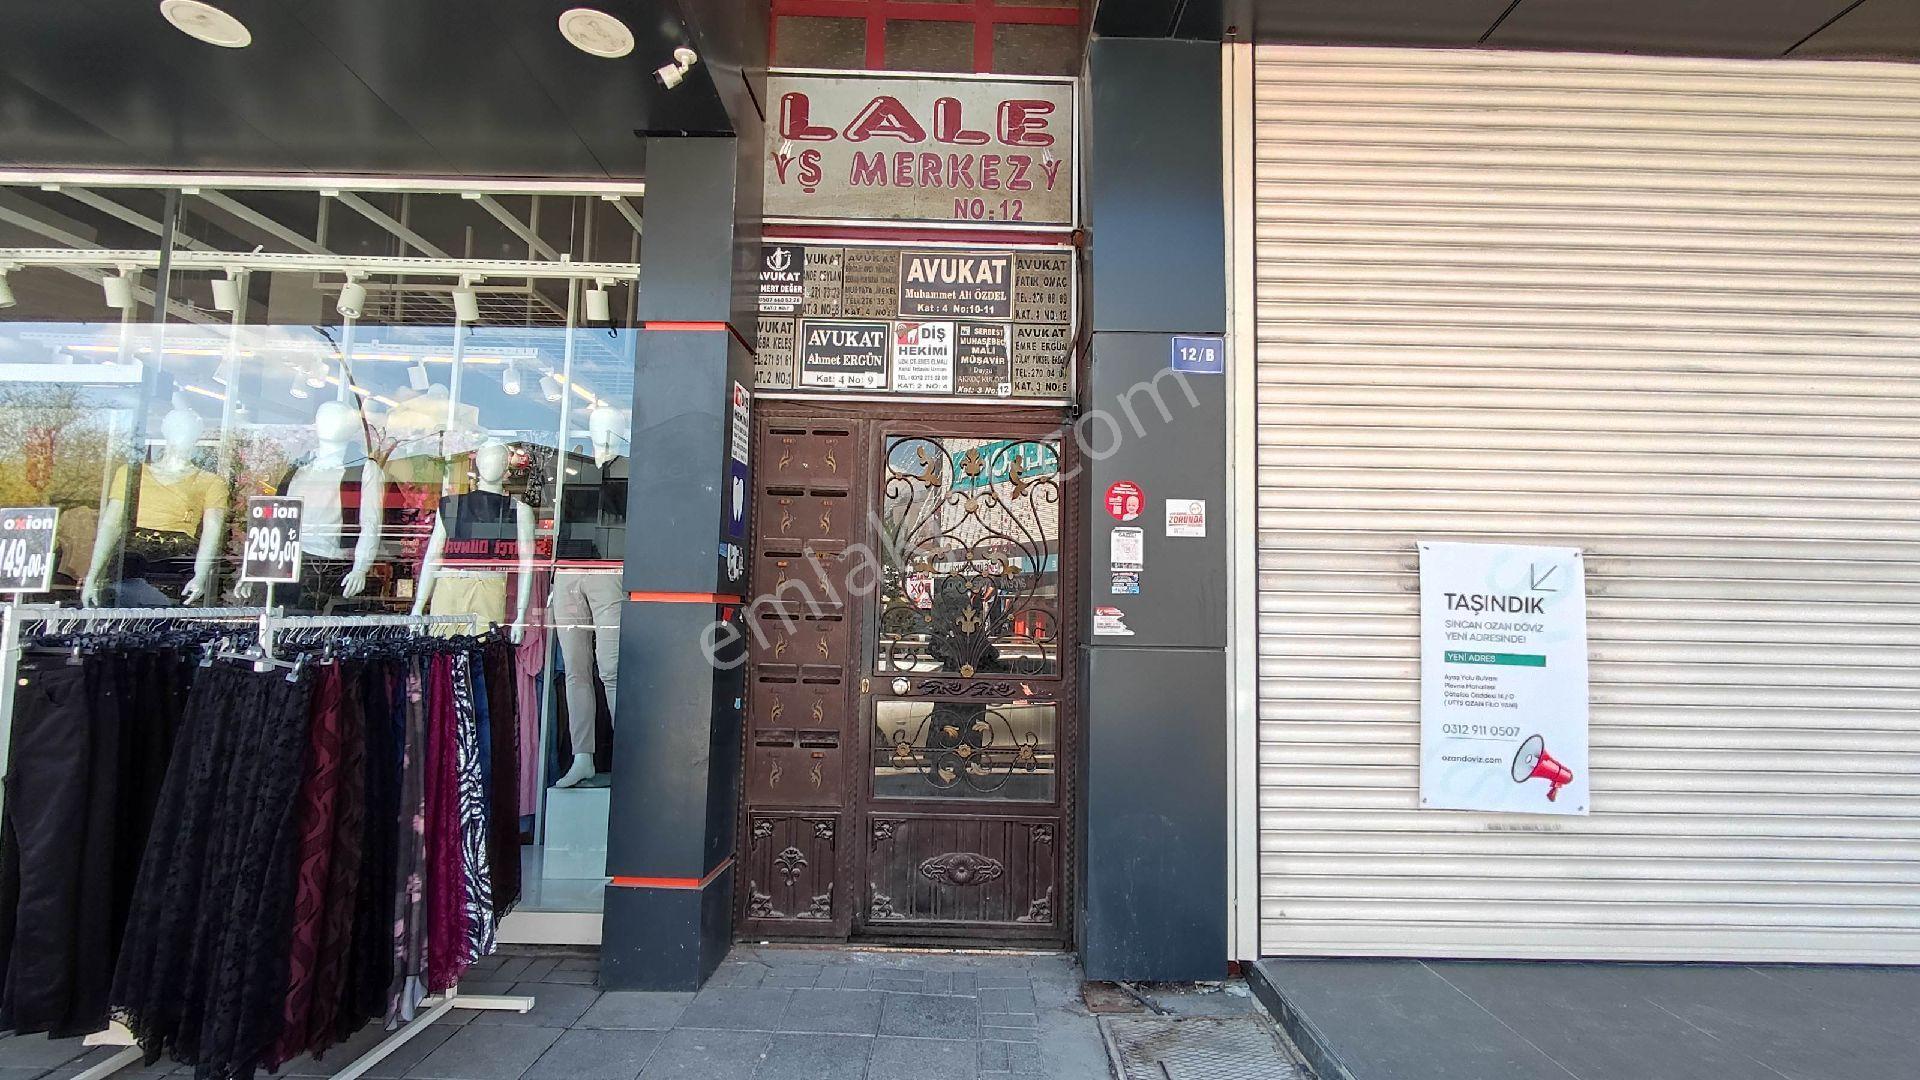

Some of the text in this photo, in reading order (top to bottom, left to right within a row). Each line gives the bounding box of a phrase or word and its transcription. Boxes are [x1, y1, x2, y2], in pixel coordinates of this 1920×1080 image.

[779, 91, 1056, 146] LALE
[804, 253, 842, 266] VUKAT
[1016, 259, 1067, 271] AVUKAT
[907, 258, 1007, 284] AVUKAT
[760, 284, 779, 293] MERT
[905, 288, 1007, 301] Muhammet Ali ÖZDEL
[757, 321, 793, 334] VUKAT
[921, 325, 946, 342] DİŞ
[1018, 328, 1066, 338] AVUKAT
[808, 329, 884, 348] AVUKAT
[898, 344, 948, 356] HEKİMİ
[1180, 347, 1215, 362] 12/B
[807, 351, 883, 366] Ahmet ERGÜN
[960, 354, 1005, 365] MÜŞAVİR
[867, 376, 874, 385] 9
[999, 385, 1009, 393] 12
[1444, 593, 1545, 615] TAŞINDIK
[1444, 618, 1483, 629] SİNCAN
[1484, 621, 1512, 631] OZAN
[1445, 631, 1468, 641] YENİ
[1447, 652, 1496, 663] YENİ ADRES
[1442, 723, 1521, 737] 0312 911 0507
